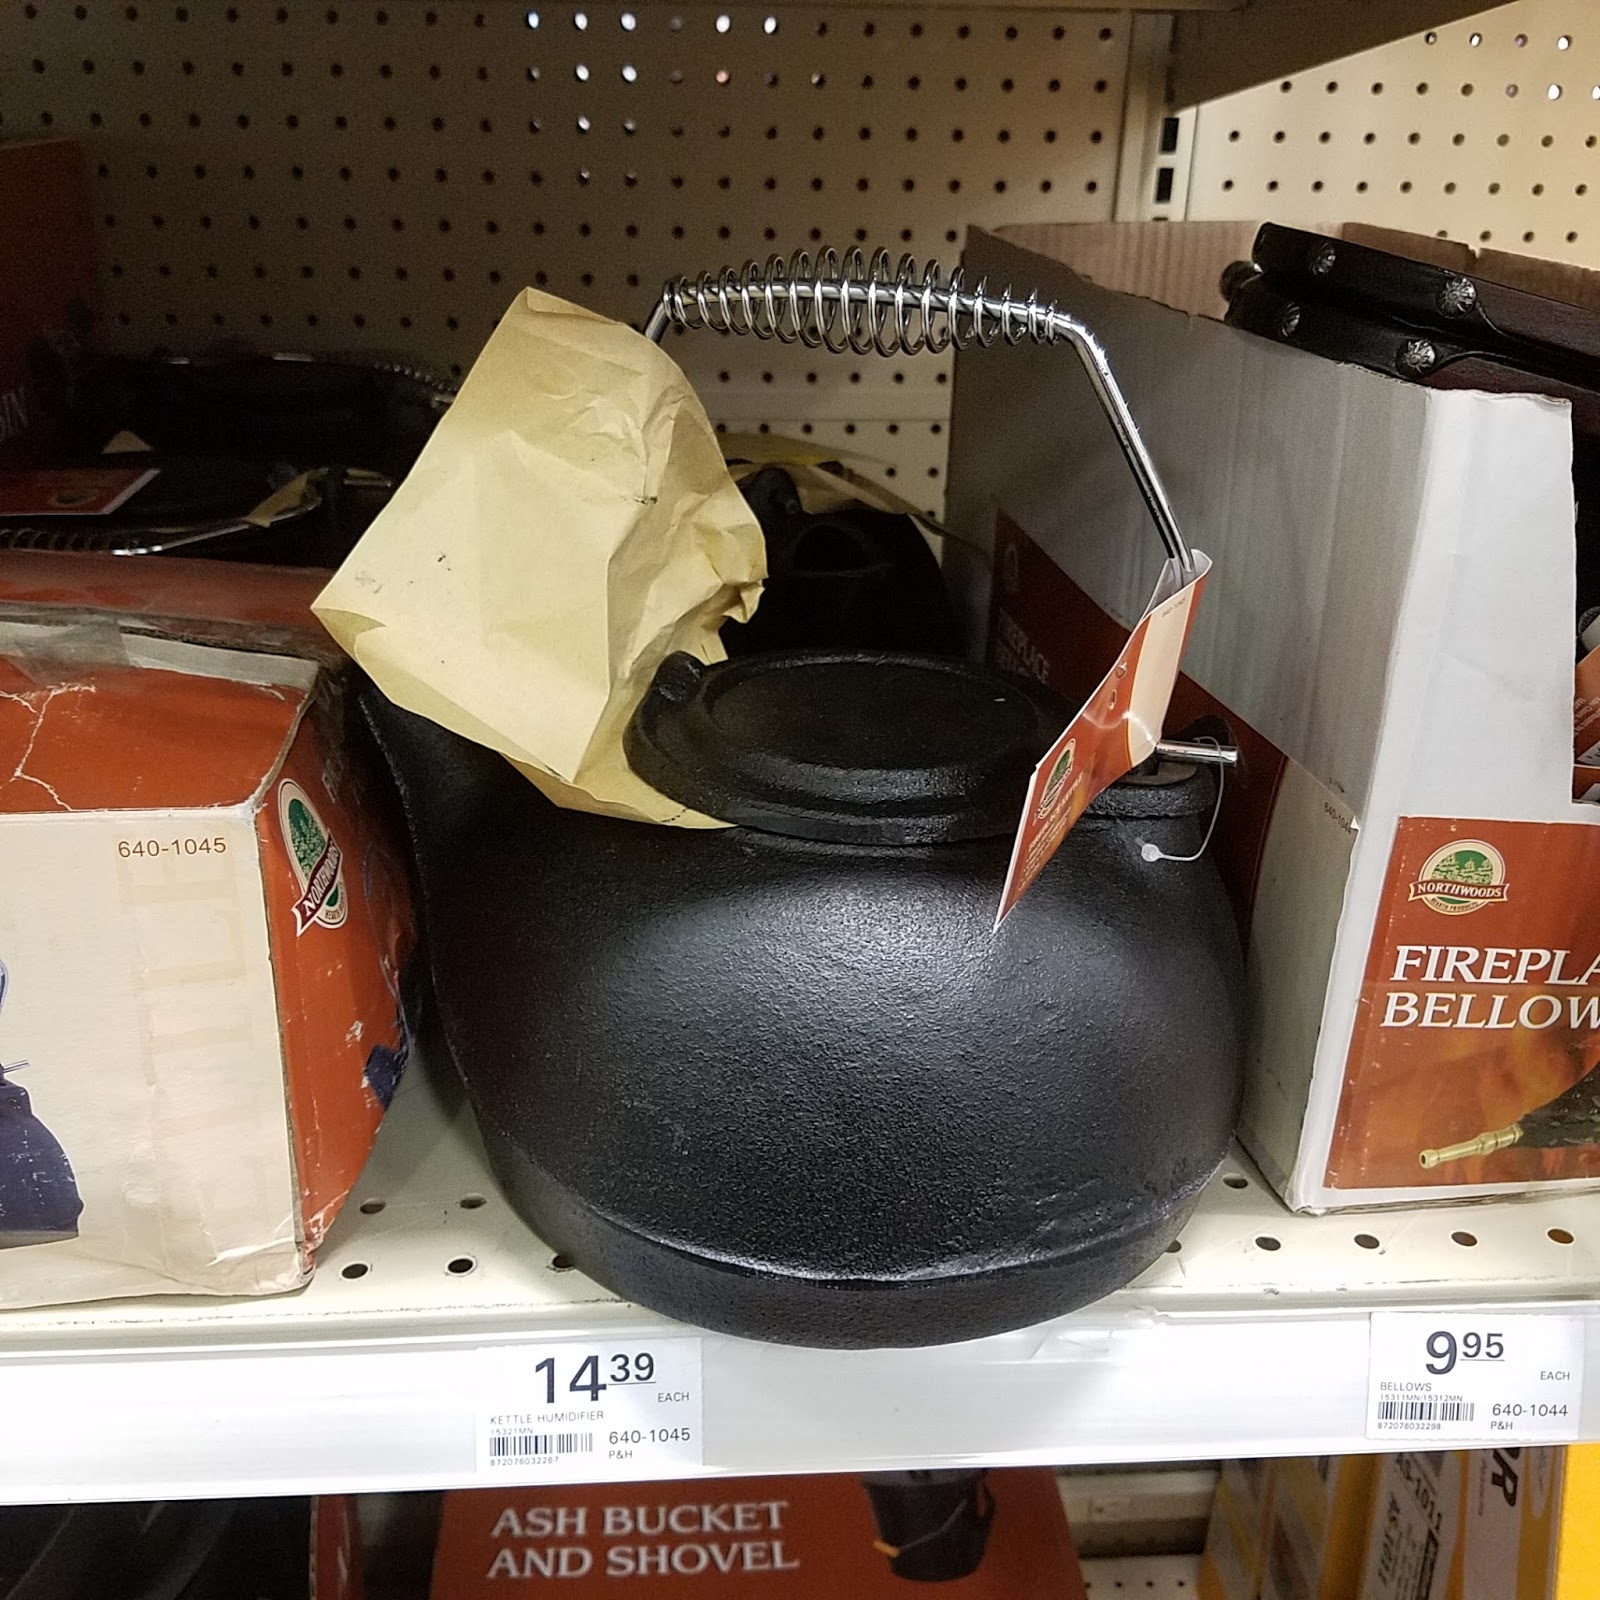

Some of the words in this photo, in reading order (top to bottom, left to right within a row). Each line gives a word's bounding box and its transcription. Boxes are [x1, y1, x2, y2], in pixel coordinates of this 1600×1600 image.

[117, 838, 227, 858] 640-1045
[1416, 882, 1502, 898] NORTHWOODS
[1380, 992, 1600, 1029] BELLOW
[1540, 1370, 1571, 1382] EACH
[1379, 1381, 1433, 1392] BELLOWS
[657, 1391, 690, 1403] EACH
[1491, 1403, 1569, 1417] 640-1044
[489, 1413, 533, 1425] KETTLE
[537, 1410, 605, 1424] HUMIDIFIER
[1490, 1420, 1514, 1431] P&H
[608, 1427, 692, 1446] 640-1045
[490, 1456, 560, 1467] 872076032267
[608, 1449, 634, 1461] P&H
[490, 1506, 588, 1538] ASH
[603, 1500, 790, 1536] BUCKET
[486, 1545, 594, 1579] AND
[605, 1540, 800, 1577] SHOVEL
